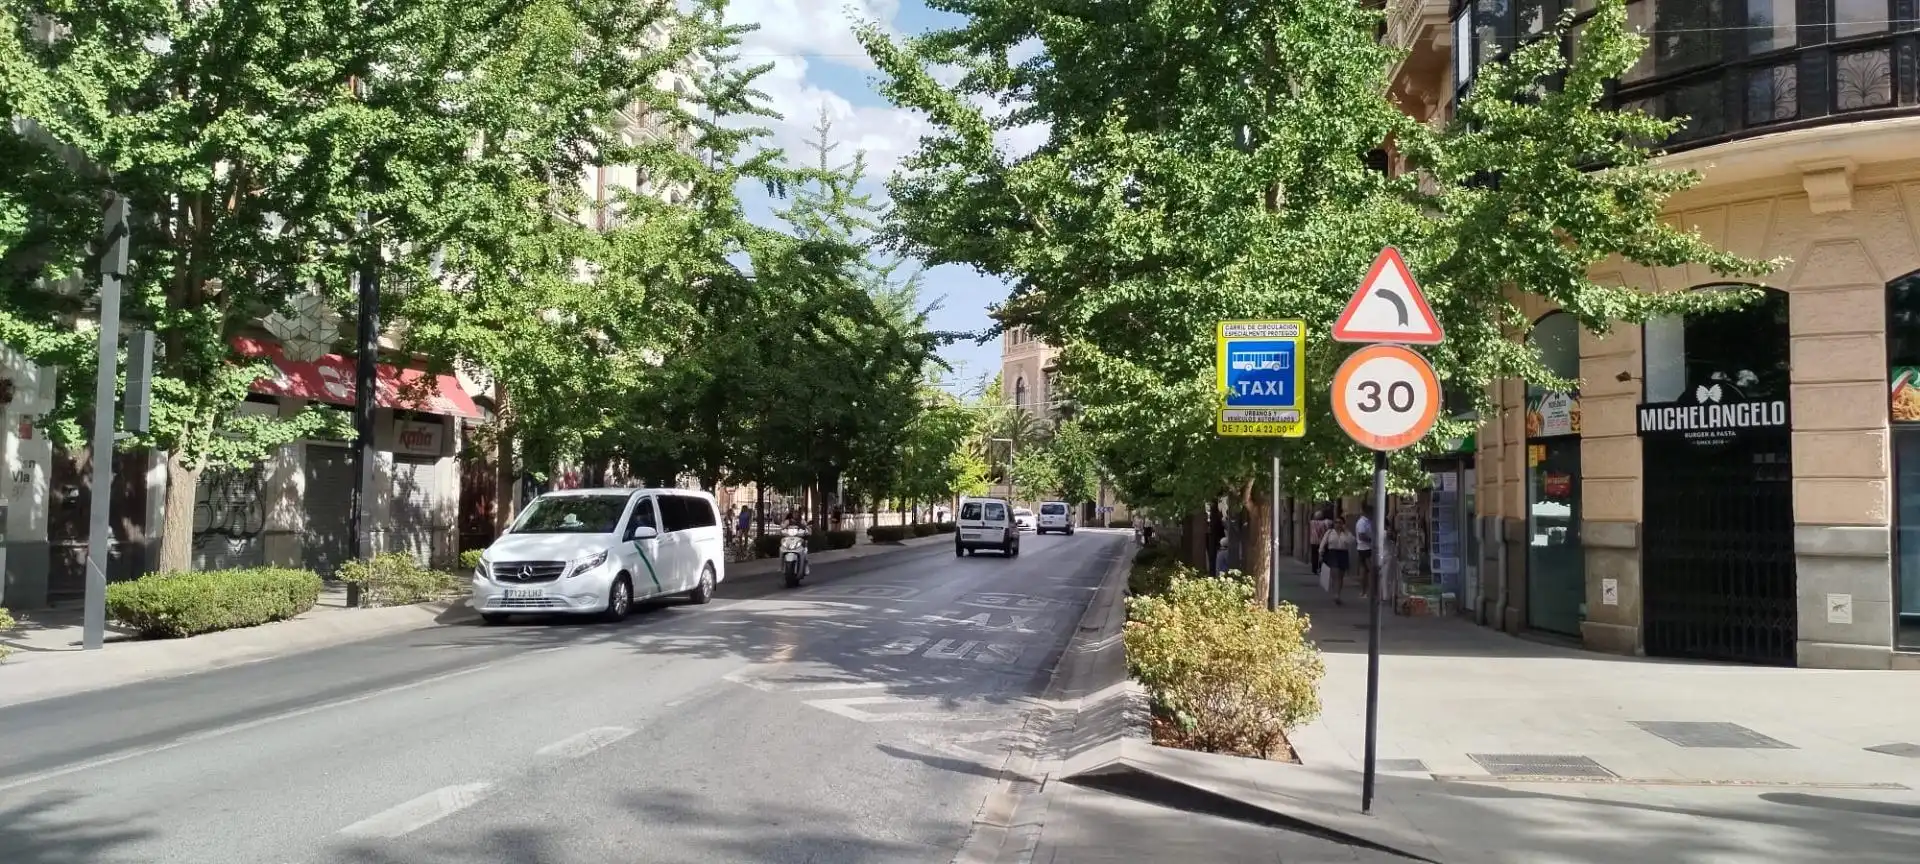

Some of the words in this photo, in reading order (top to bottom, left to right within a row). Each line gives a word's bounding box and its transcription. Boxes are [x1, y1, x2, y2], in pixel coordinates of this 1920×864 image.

[1238, 380, 1284, 396] TAXI
[1357, 380, 1415, 413] 30
[1222, 425, 1233, 433] DE
[1256, 425, 1262, 433] A
[1289, 424, 1295, 432] H
[1640, 401, 1786, 432] MICHELANGELO
[861, 635, 1025, 664] BUS
